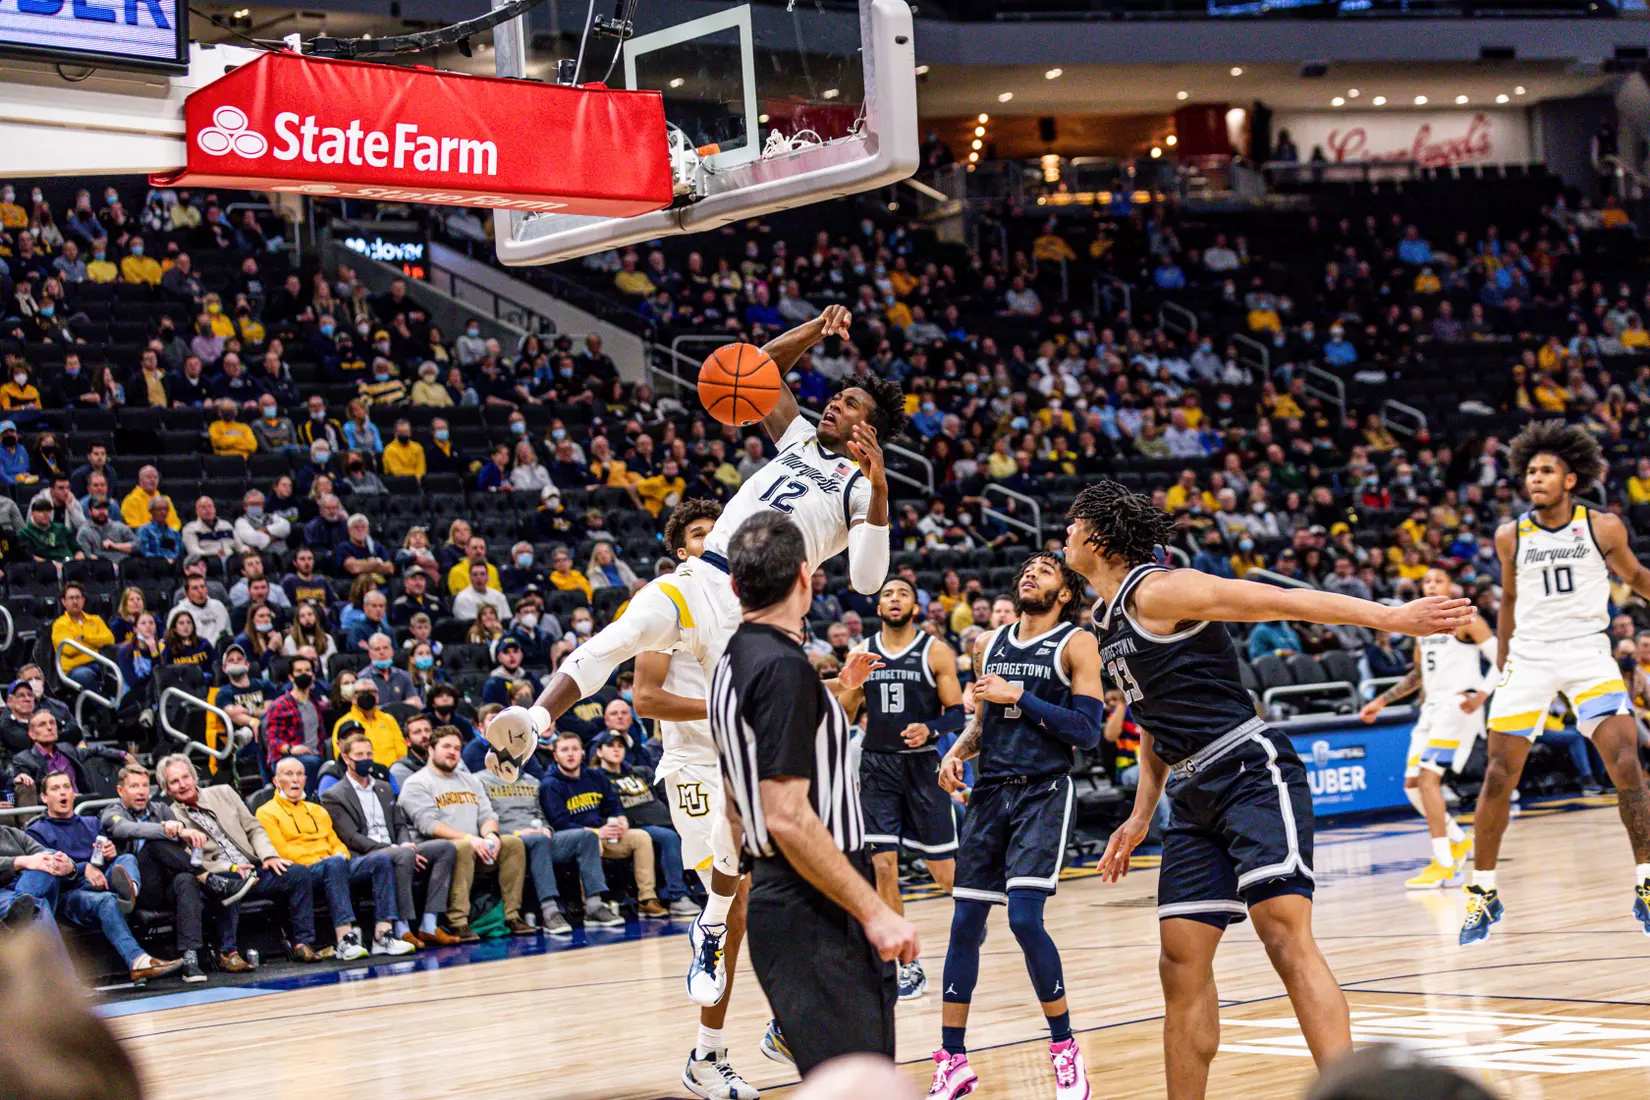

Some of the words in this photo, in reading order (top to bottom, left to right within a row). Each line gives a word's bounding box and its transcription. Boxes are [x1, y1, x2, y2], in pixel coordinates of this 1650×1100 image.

[775, 451, 841, 495] Marquette
[758, 474, 810, 514] 12
[1524, 543, 1591, 565] Marquette
[1542, 566, 1576, 597] 10
[867, 669, 921, 682] EORGETOWN
[986, 662, 1052, 680] GEORGETOWN
[1427, 650, 1437, 672] 5
[1107, 656, 1144, 706] 23
[880, 682, 905, 713] 13
[1306, 765, 1368, 796] UBER
[434, 791, 479, 808] MARQUETTE
[676, 782, 710, 818] MU
